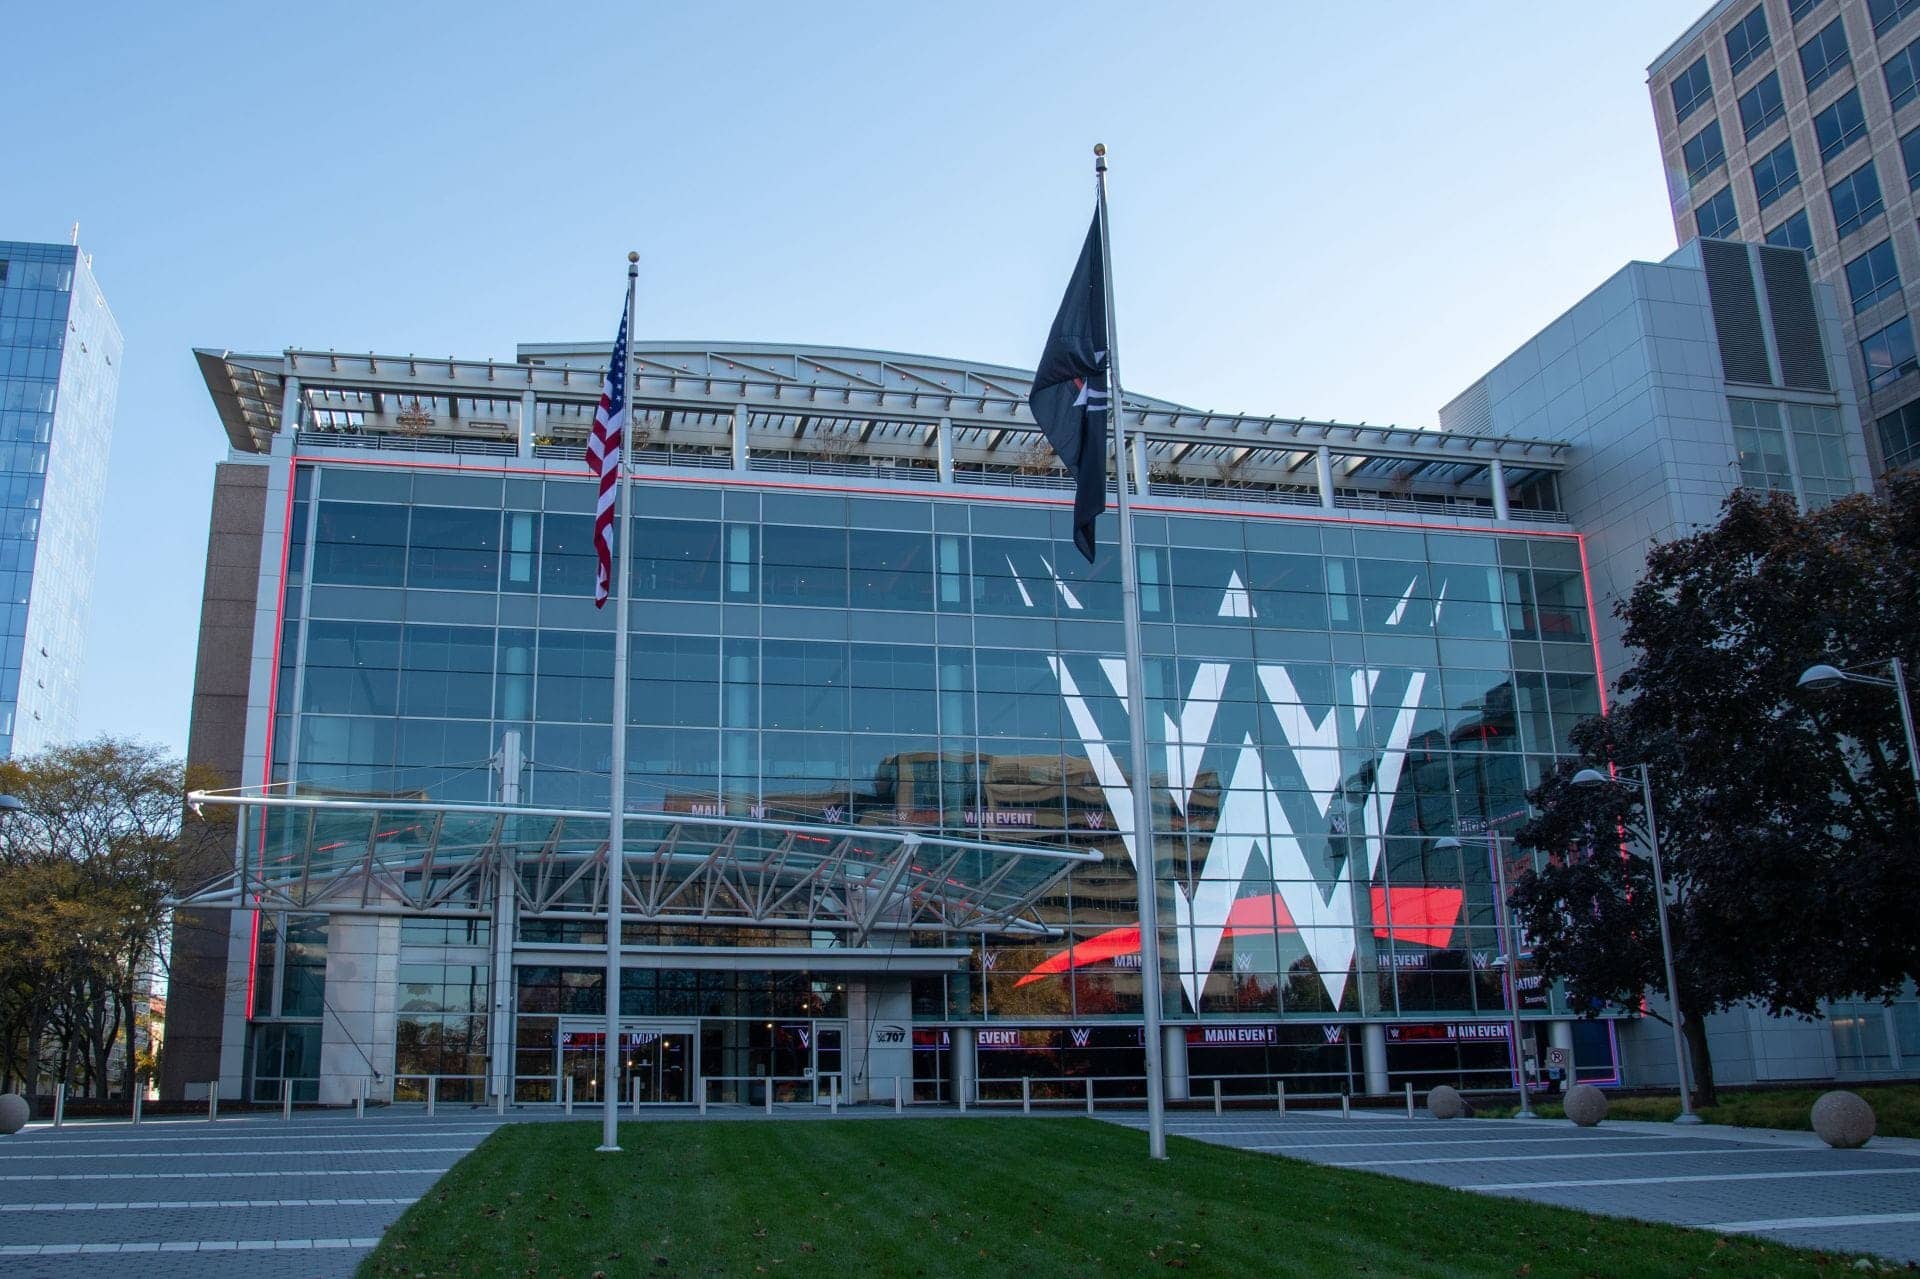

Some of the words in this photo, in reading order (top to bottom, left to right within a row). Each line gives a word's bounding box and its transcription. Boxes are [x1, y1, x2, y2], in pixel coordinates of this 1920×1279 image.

[996, 812, 1033, 825] EVENT
[1393, 955, 1425, 967] EVENT
[979, 1032, 1017, 1044] EVENT
[1205, 1030, 1237, 1042] MAIN
[1238, 1029, 1273, 1042] EVENT
[1447, 1025, 1477, 1038] MAIN
[1478, 1025, 1509, 1037] EVENT
